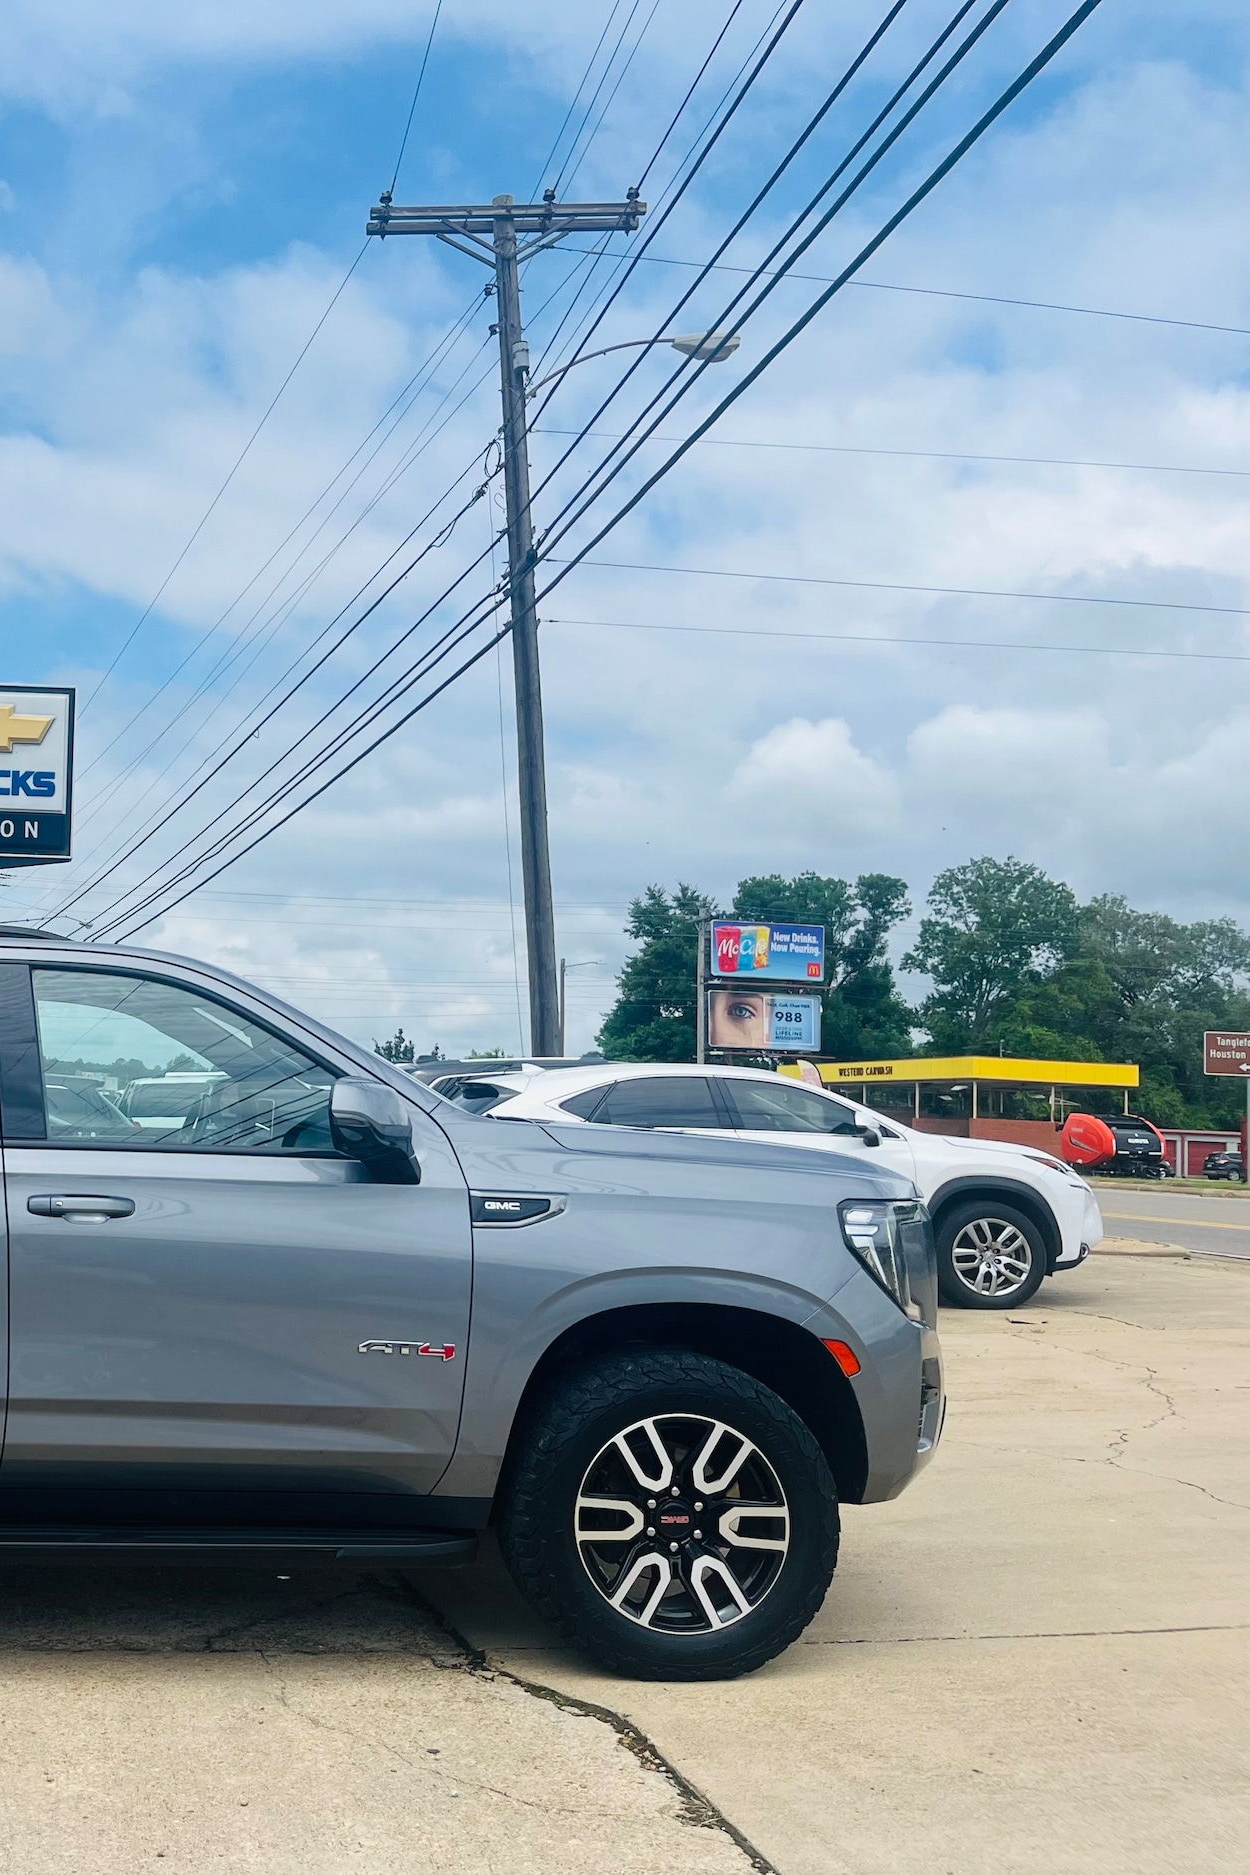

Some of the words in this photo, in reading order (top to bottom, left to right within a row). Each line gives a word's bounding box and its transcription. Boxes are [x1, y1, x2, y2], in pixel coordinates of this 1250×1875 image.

[773, 932, 791, 942] New
[792, 933, 819, 944] Drinks.
[770, 942, 788, 952] Now
[790, 943, 821, 957] Pouring.
[775, 1011, 802, 1023] 988
[1210, 1049, 1246, 1059] Houston
[865, 1066, 893, 1076] CARWASH
[484, 1201, 520, 1210] GMC
[358, 1339, 455, 1361] AT4
[660, 1516, 689, 1524] GMC
